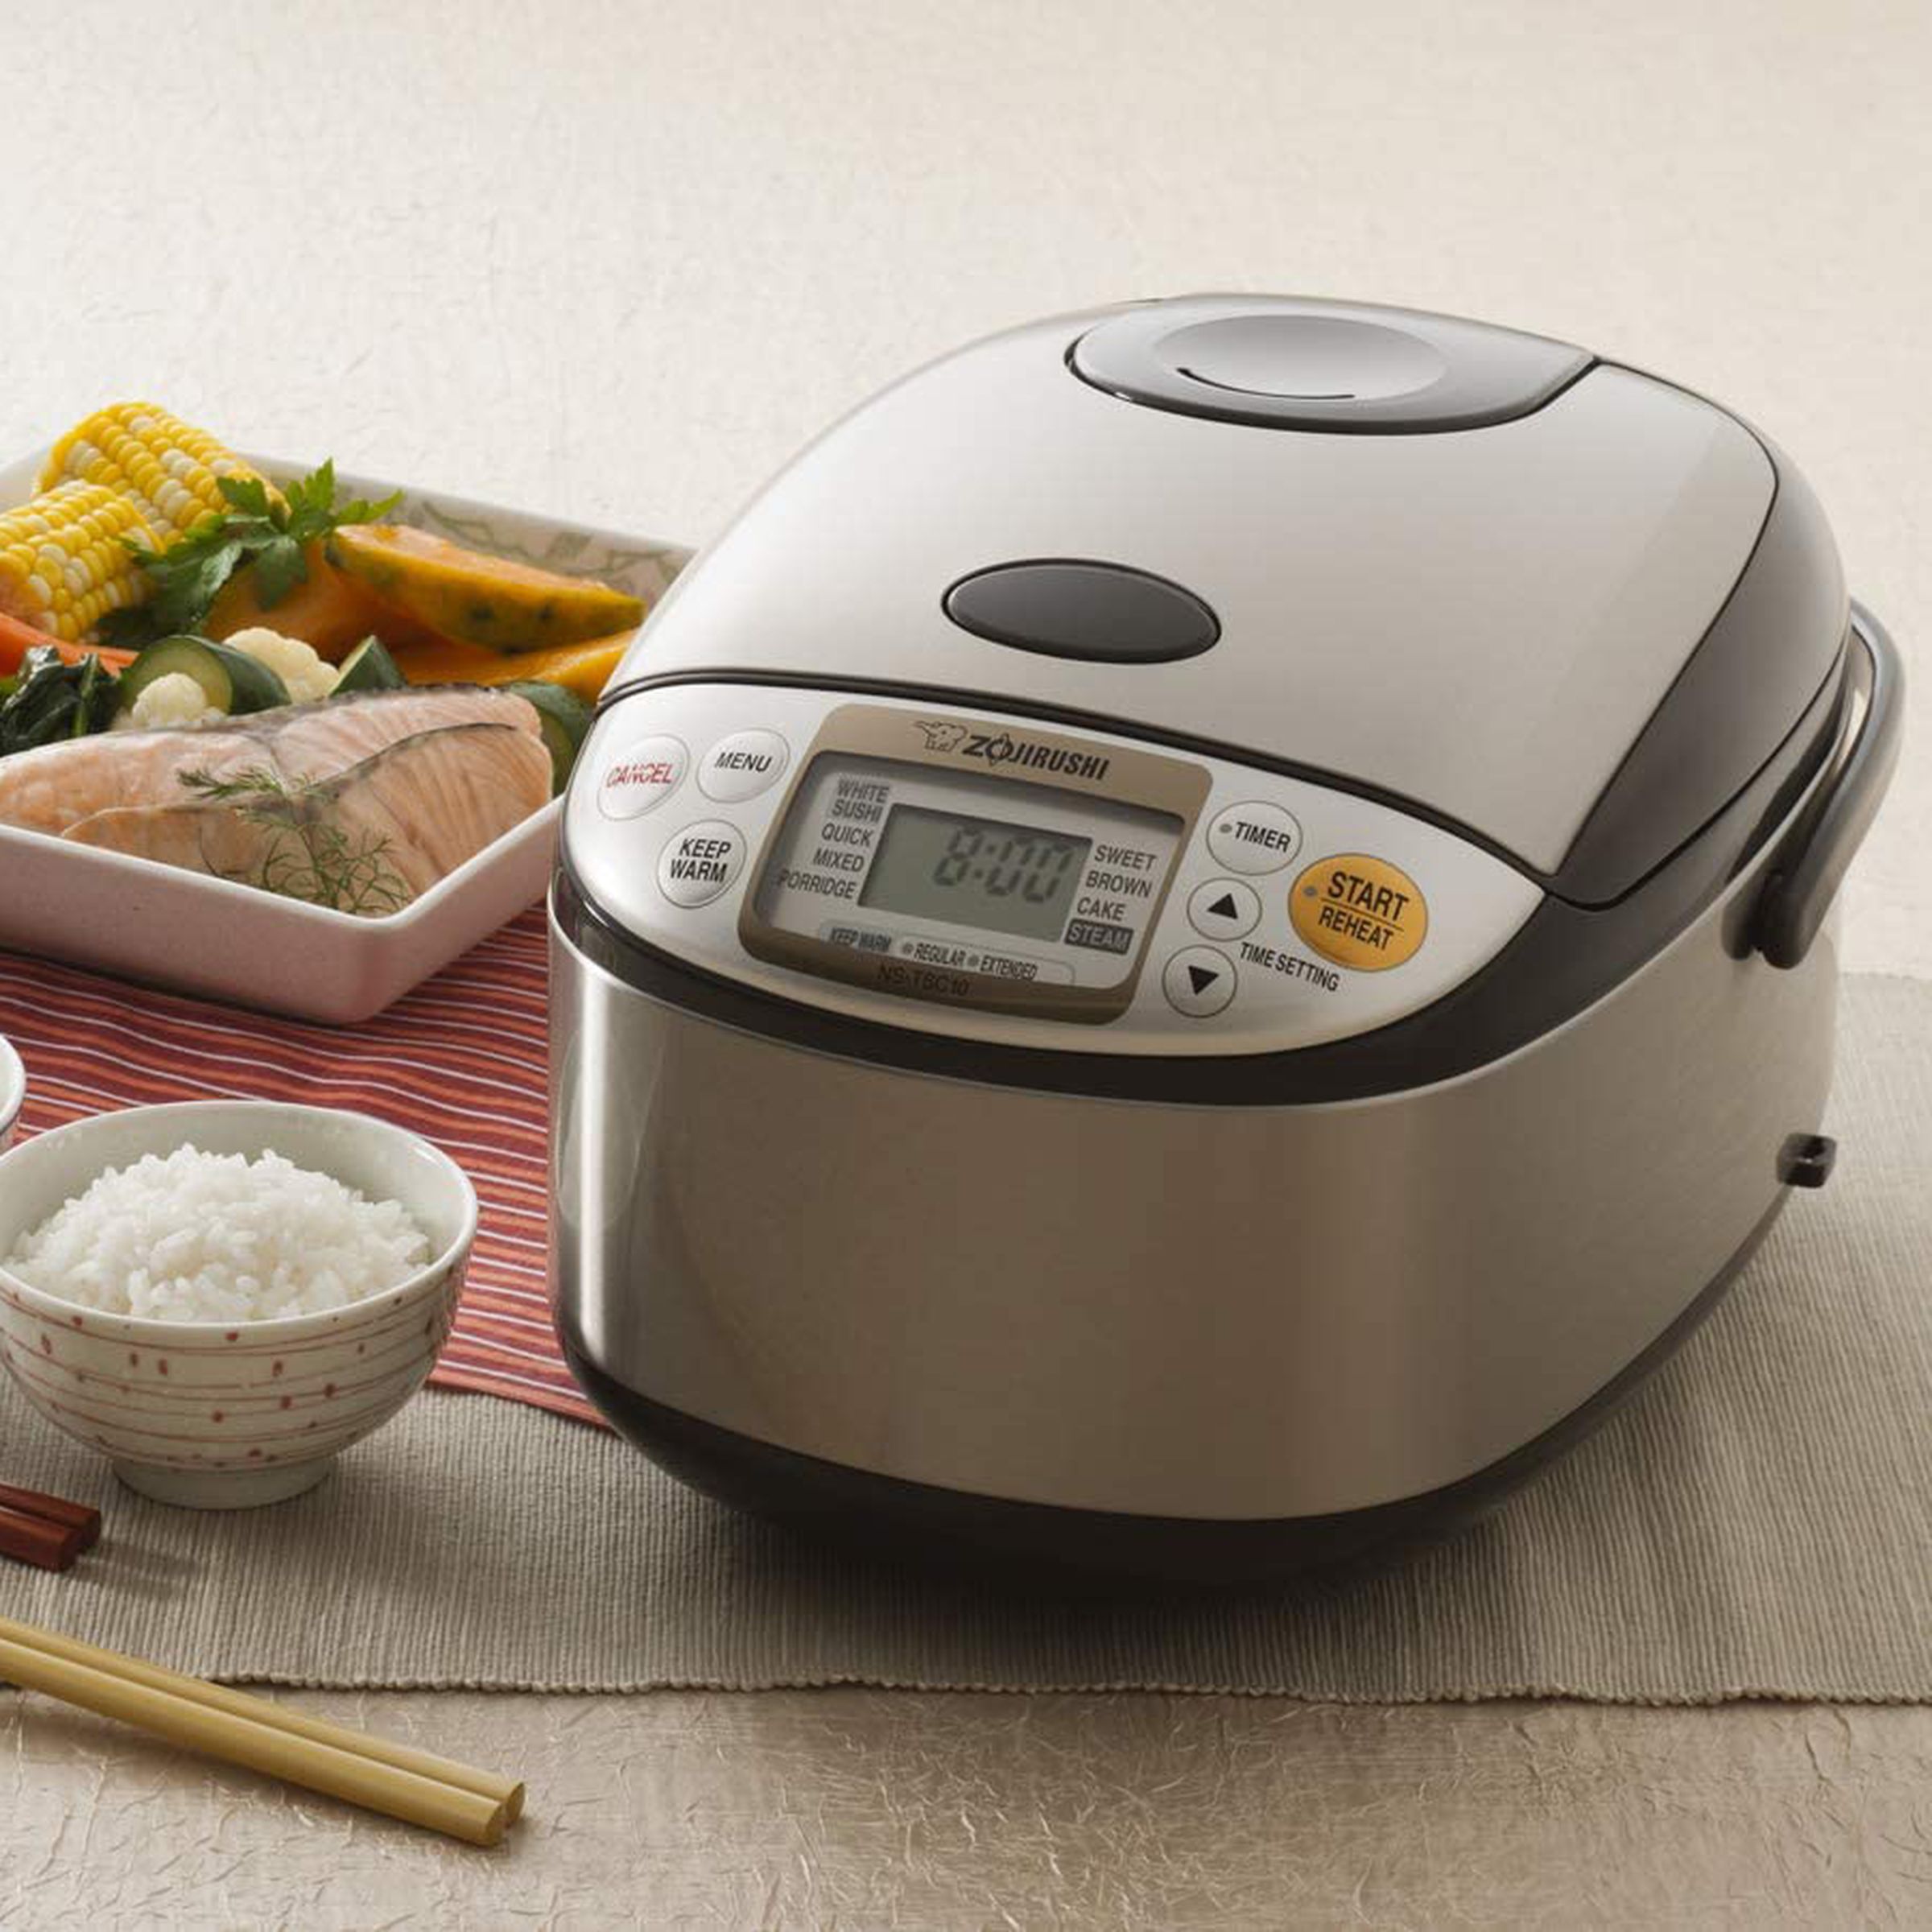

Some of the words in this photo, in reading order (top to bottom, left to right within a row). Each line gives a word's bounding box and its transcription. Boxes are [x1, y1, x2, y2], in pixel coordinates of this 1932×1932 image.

[715, 751, 772, 772] MENU
[963, 732, 1110, 780] ZOJIRUSHI
[607, 762, 673, 788] CANCEL
[837, 778, 889, 803] WHITE
[832, 798, 884, 823] SUSHI
[821, 822, 874, 847] QUICK
[1235, 820, 1291, 853] TIMER
[679, 838, 732, 859] KEEP
[812, 847, 864, 873] MIXED
[1095, 844, 1157, 871] SWEET
[669, 859, 728, 882] WARM
[932, 827, 1074, 903] 8:00
[778, 868, 857, 899] PORRIDGE
[1087, 870, 1152, 898] BROWN
[1327, 871, 1409, 922] START
[1077, 897, 1125, 922] CAKE
[1068, 927, 1129, 952] STEAM
[1318, 906, 1394, 951] REHEAT
[830, 927, 857, 945] KEEP
[858, 933, 891, 952] WARM
[914, 942, 966, 966] REGULAR
[980, 954, 1038, 980] EXTENDED
[1240, 941, 1276, 968] TIME
[1275, 956, 1340, 992] SETTING
